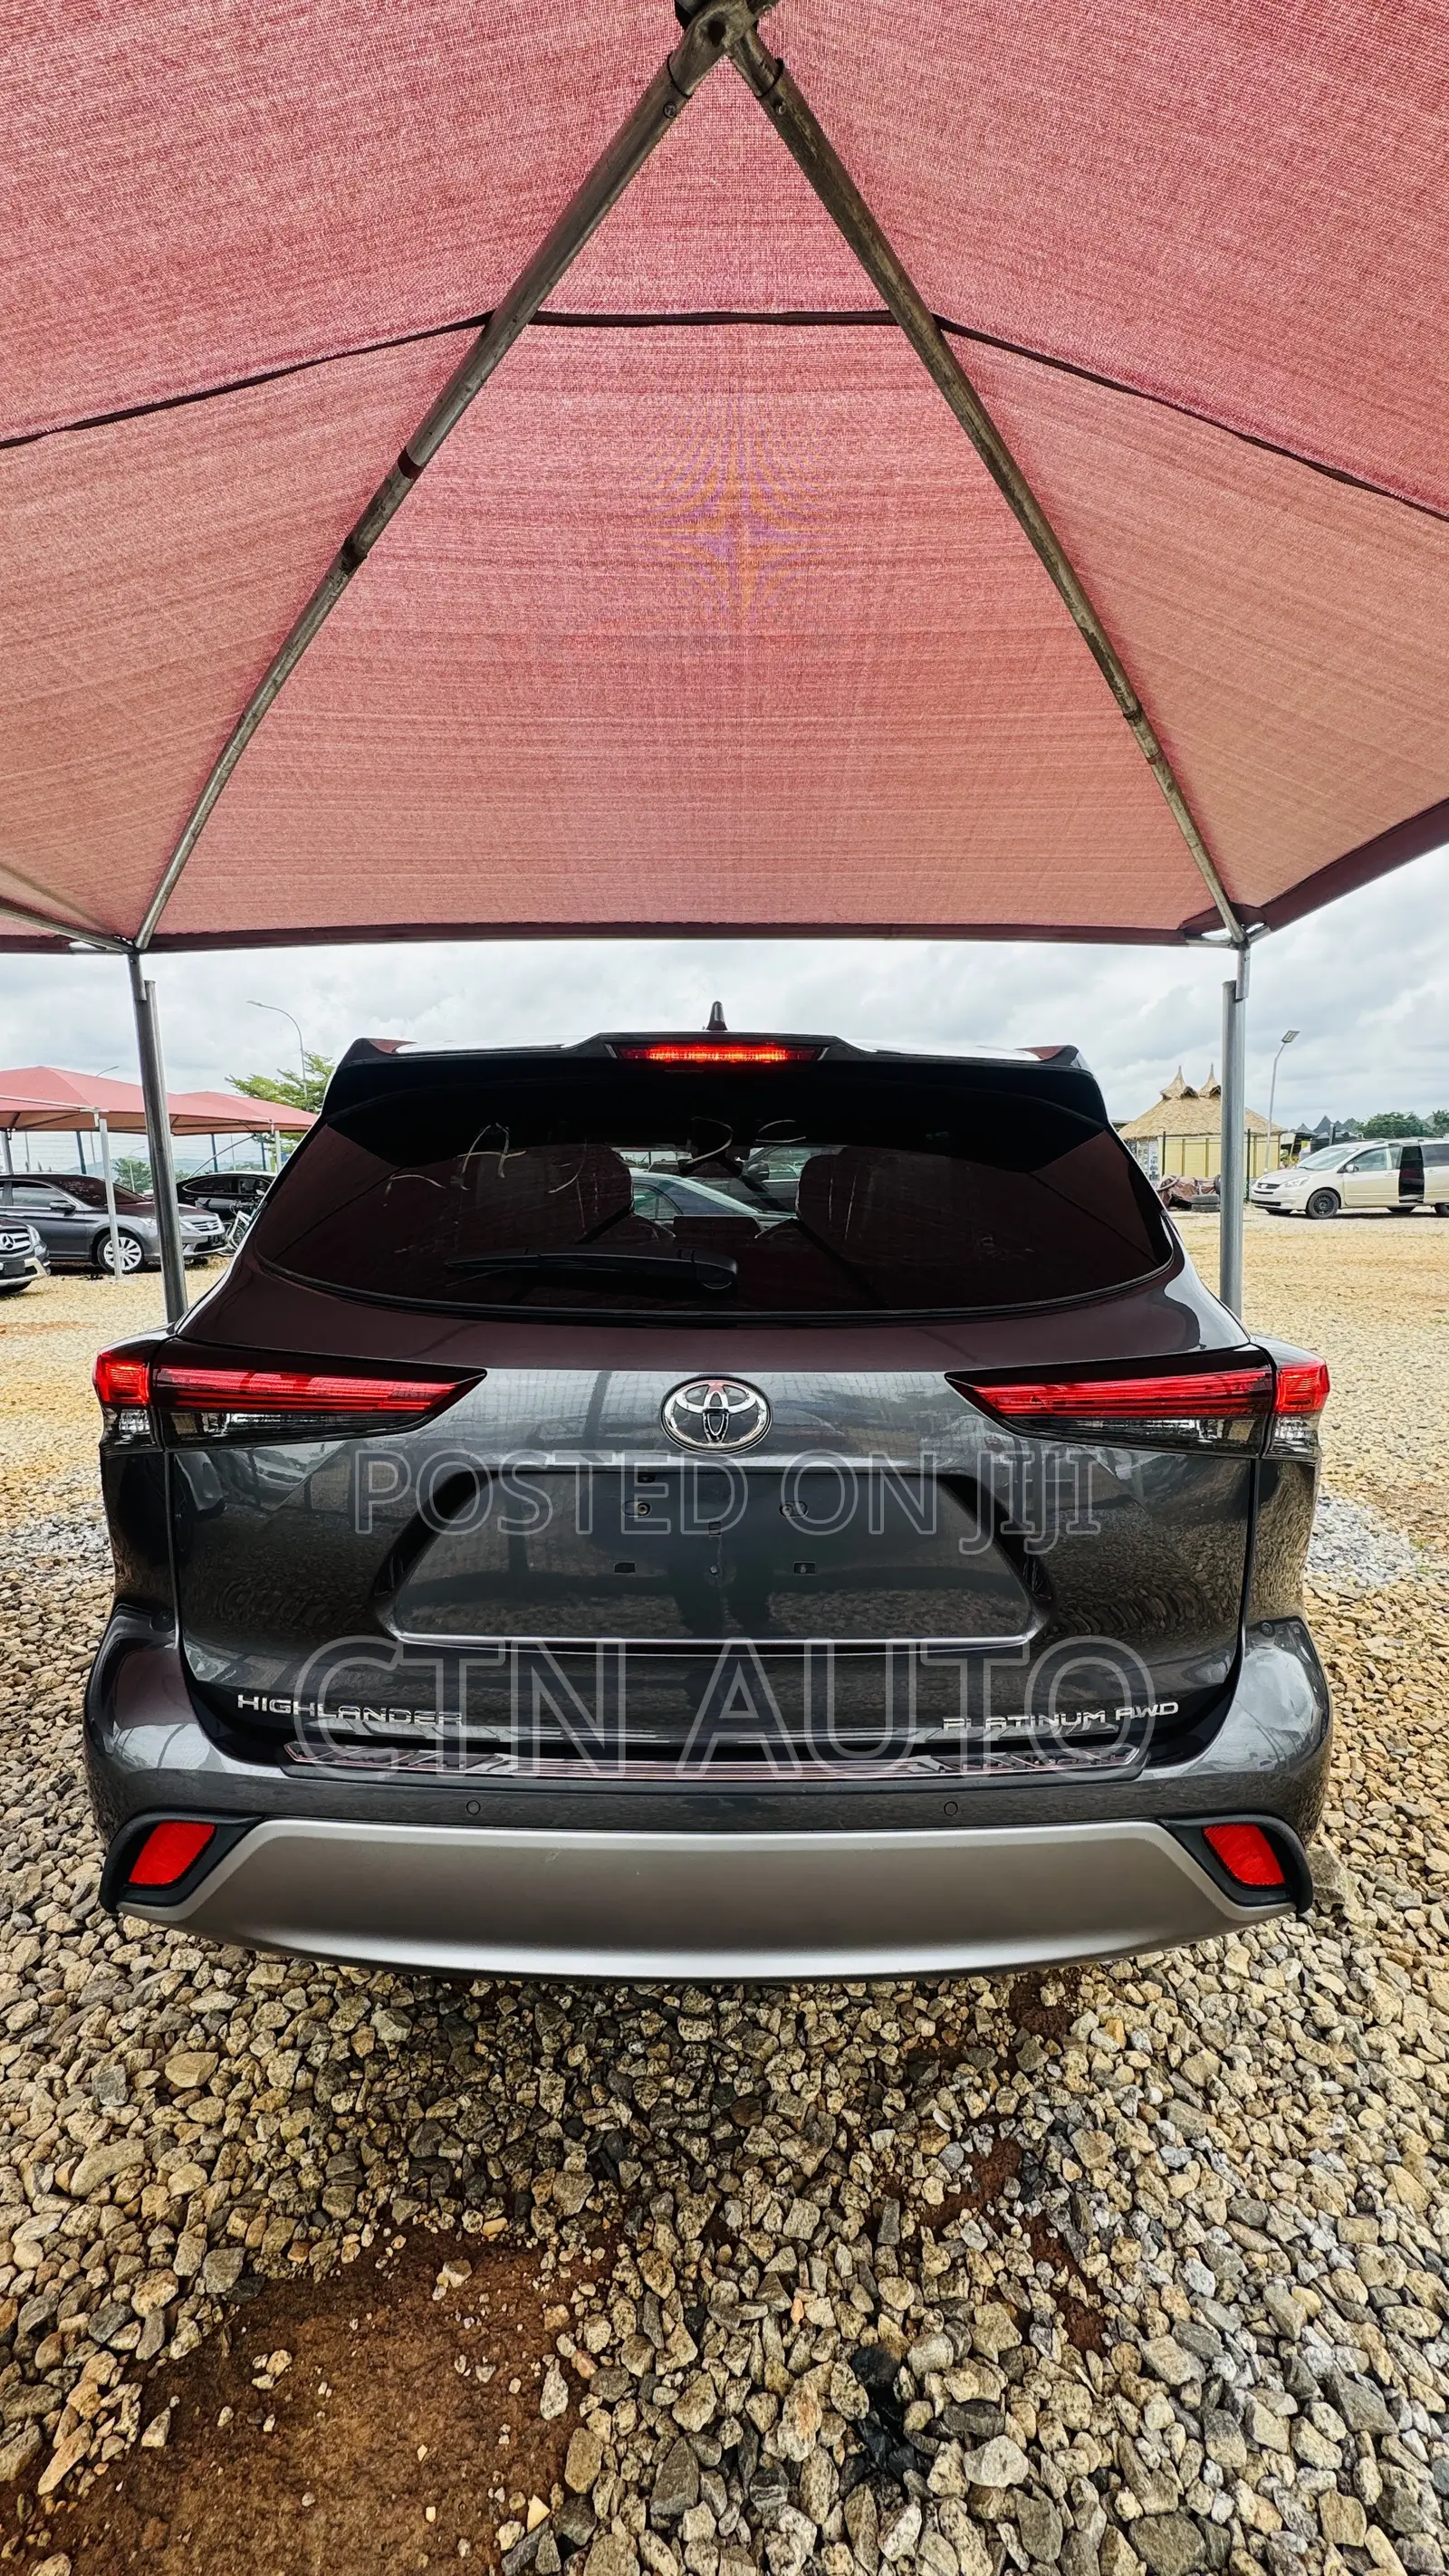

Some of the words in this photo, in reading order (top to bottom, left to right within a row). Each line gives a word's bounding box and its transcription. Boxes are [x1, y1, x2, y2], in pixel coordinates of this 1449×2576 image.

[237, 1694, 464, 1727] HIGHLANDER
[943, 1709, 1107, 1731] PLATINUM
[1115, 1701, 1179, 1723] AWD
